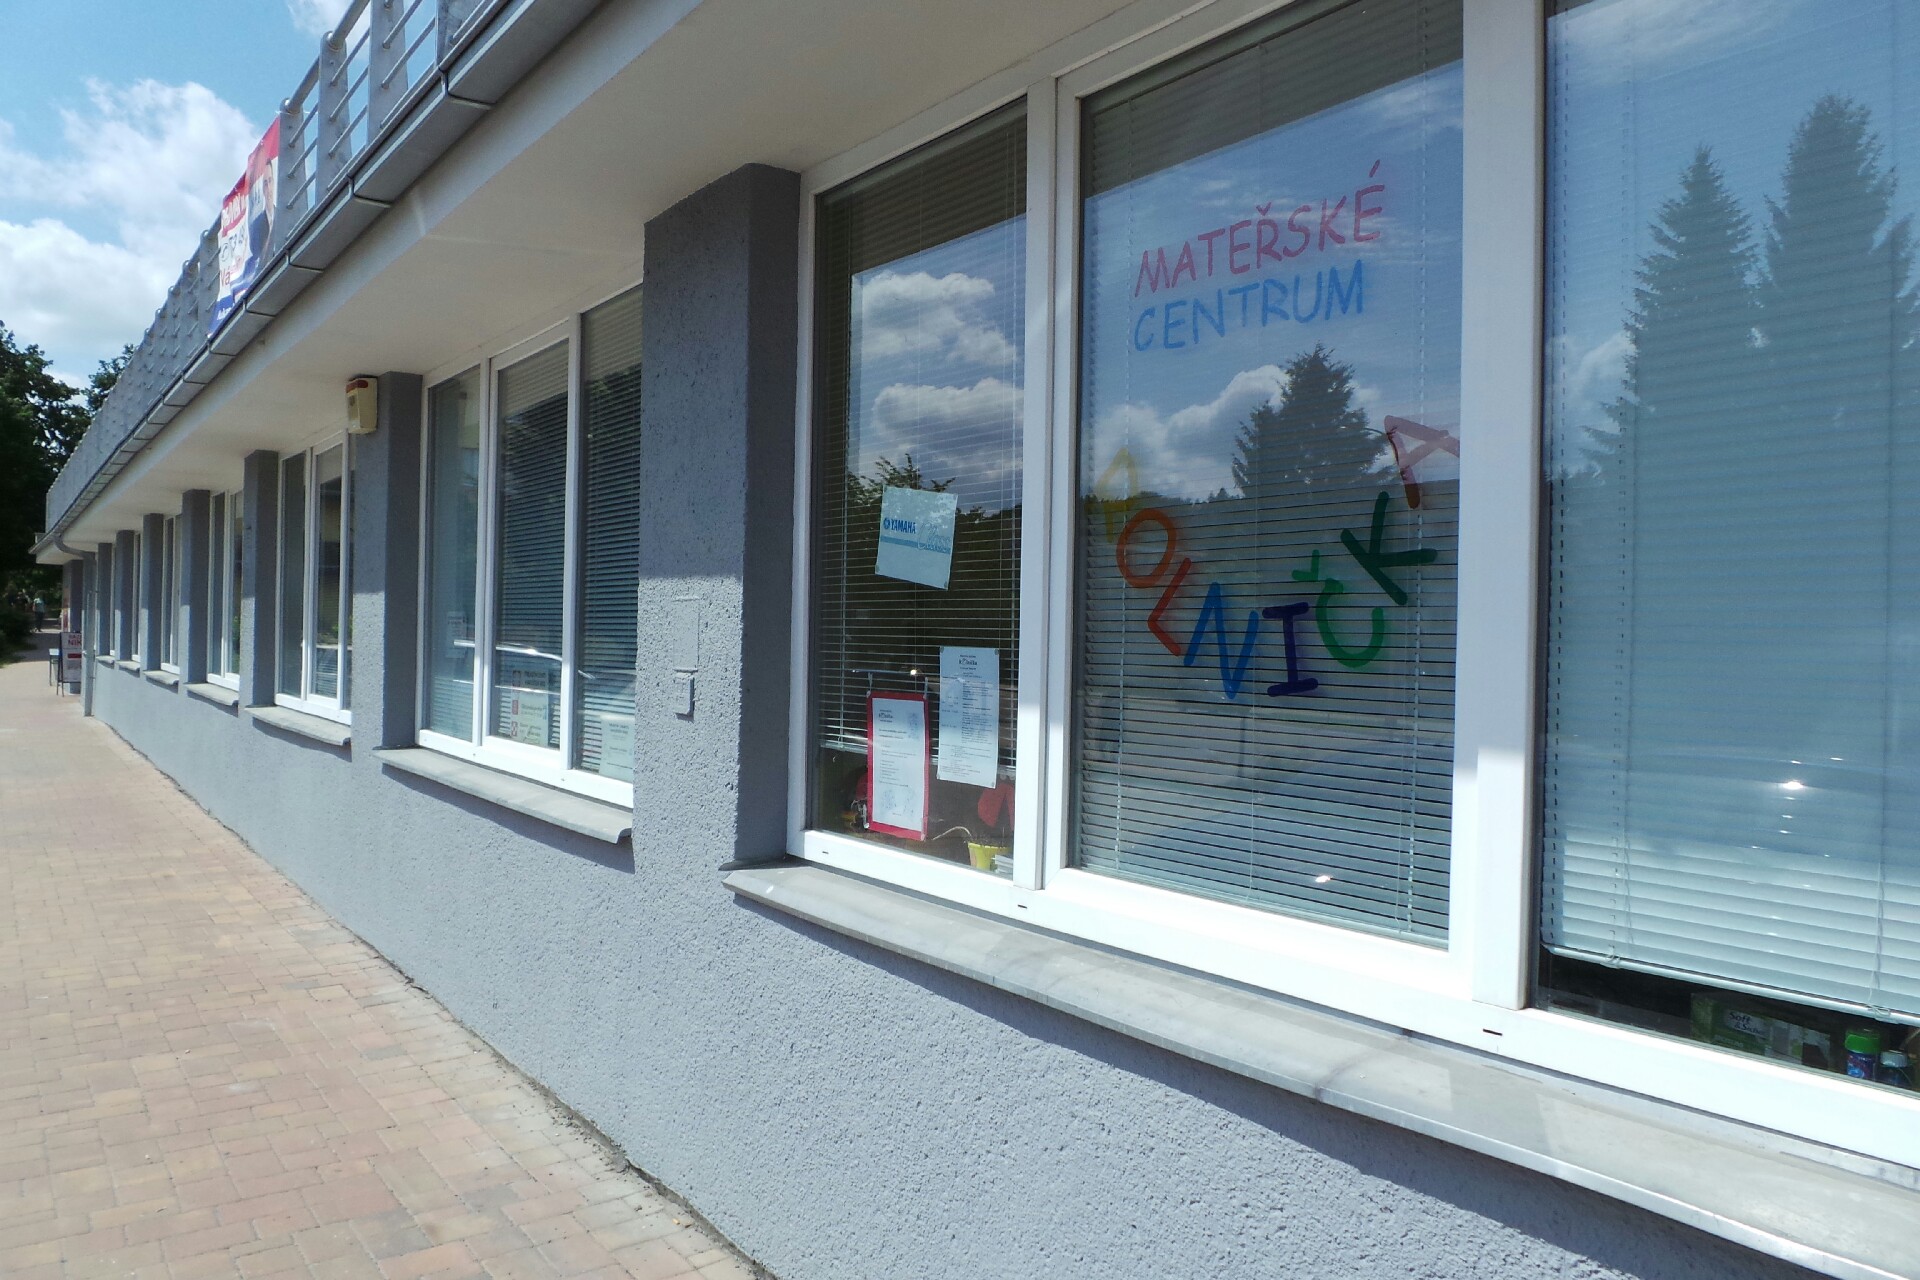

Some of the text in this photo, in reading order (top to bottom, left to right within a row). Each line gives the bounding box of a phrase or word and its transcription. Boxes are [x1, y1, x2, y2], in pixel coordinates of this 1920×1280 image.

[1134, 159, 1385, 298] MATEŘSKÉ
[1133, 259, 1364, 353] CENTRUM
[890, 518, 917, 535] YAMAHA
[1728, 1011, 1750, 1024] Soft
